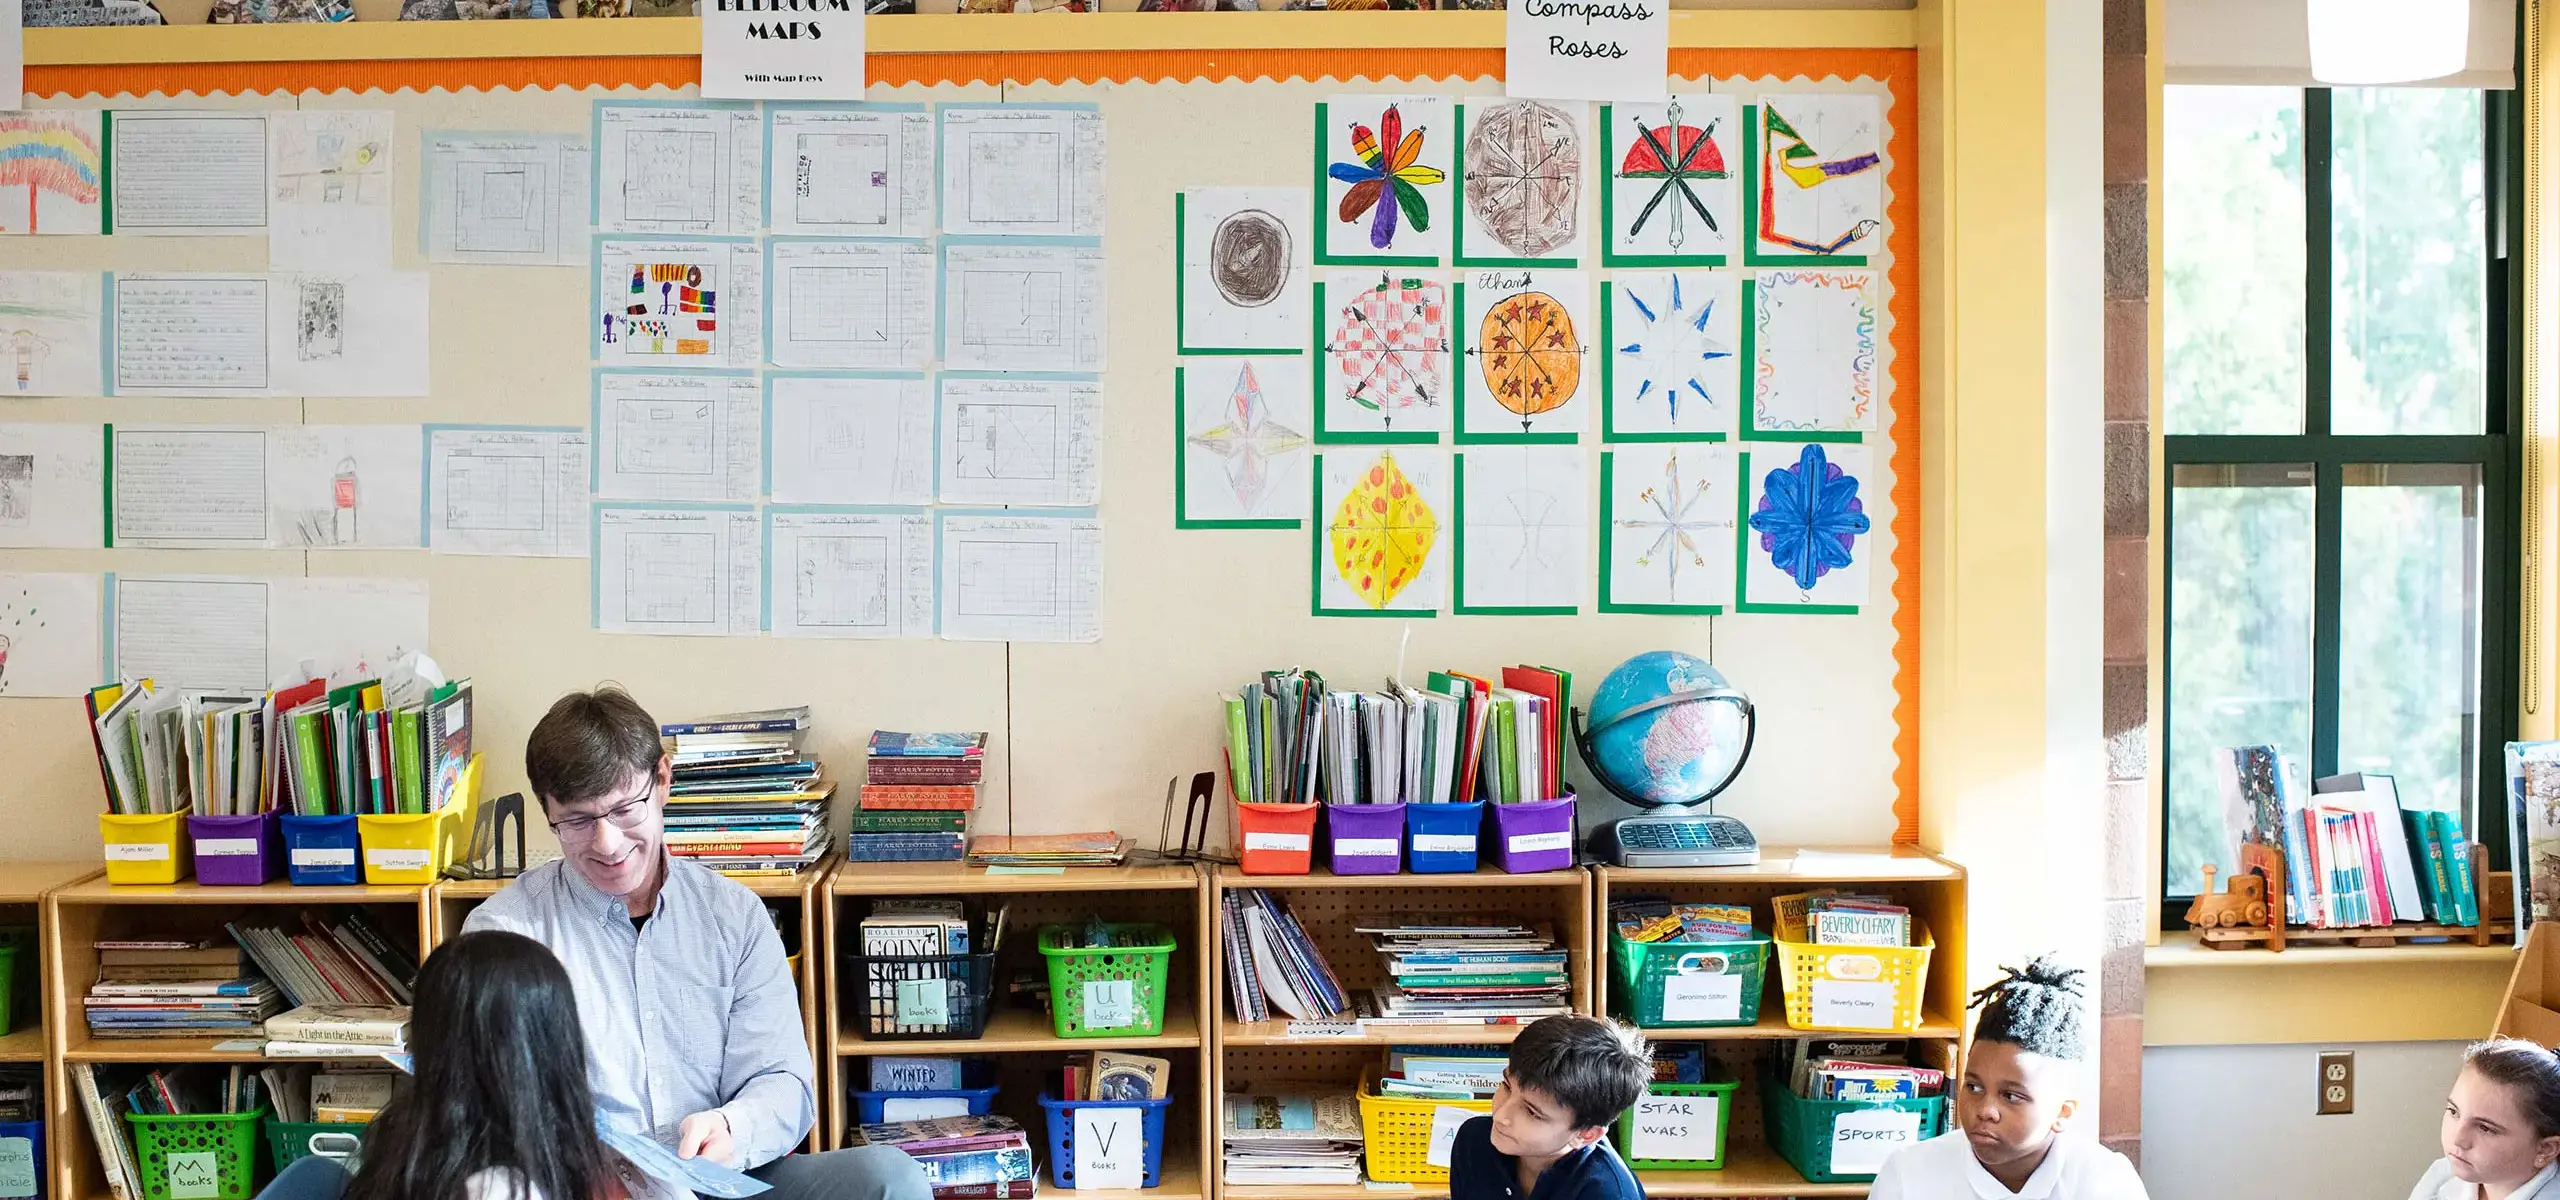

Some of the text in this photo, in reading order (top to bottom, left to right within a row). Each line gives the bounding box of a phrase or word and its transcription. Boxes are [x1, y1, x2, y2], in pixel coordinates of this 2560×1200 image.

[717, 0, 850, 12] BEDROOM
[1525, 0, 1654, 25] Compass
[745, 21, 822, 40] MAPS
[1549, 36, 1628, 59] Roses
[745, 74, 823, 85] With Map Keys
[1478, 272, 1524, 290] Ethan
[1800, 588, 1811, 603] S
[687, 844, 742, 852] EVERYTHING
[1822, 915, 1861, 934] BEVERLY
[1862, 916, 1896, 936] CLEARY
[868, 938, 936, 958] GOING
[1489, 977, 1521, 985] Encyclopedia
[906, 981, 932, 1006] T
[1095, 984, 1116, 1006] U
[1677, 993, 1706, 1001] Geronimo
[1830, 999, 1853, 1007] Beverly
[908, 1007, 938, 1017] books
[298, 1029, 304, 1038] A
[305, 1029, 323, 1040] Light
[324, 1030, 332, 1039] in
[332, 1029, 345, 1040] the
[345, 1029, 363, 1041] Attic
[1828, 1042, 1888, 1051] Overcoming
[891, 1068, 936, 1084] WINTER
[1640, 1103, 1694, 1116] STAR
[1642, 1126, 1688, 1137] WARS
[1838, 1129, 1907, 1142] SPORTS
[1091, 1121, 1117, 1157] V
[174, 1160, 205, 1175] M
[179, 1175, 212, 1186] books
